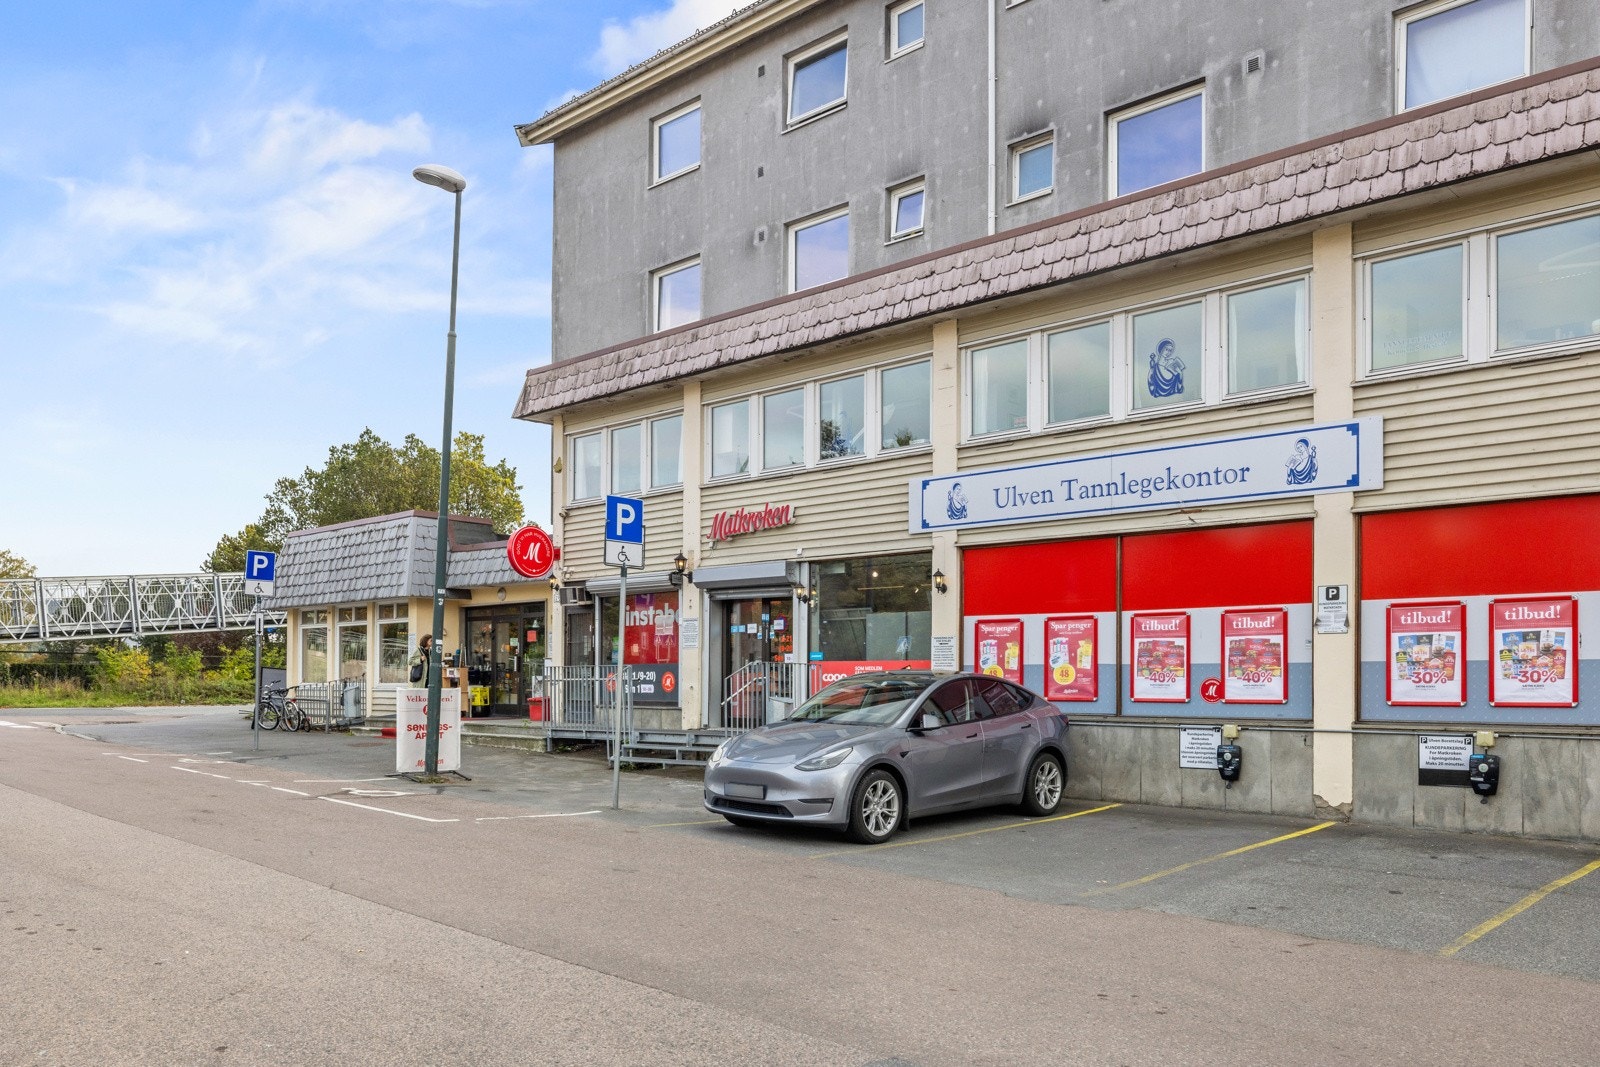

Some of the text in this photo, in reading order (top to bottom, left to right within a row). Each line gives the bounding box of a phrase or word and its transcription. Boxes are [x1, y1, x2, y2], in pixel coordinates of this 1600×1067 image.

[992, 466, 1251, 509] Ulven Tannlegekontor
[616, 502, 636, 536] P
[706, 502, 792, 541] Matkroken
[522, 542, 543, 564] M
[252, 554, 269, 577] P
[1329, 588, 1338, 599] P
[1400, 610, 1452, 624] tilbud!
[1504, 604, 1561, 621] tilbud!
[1050, 621, 1092, 631] Spar penger
[1141, 619, 1180, 631] tilbud!
[1232, 615, 1275, 629] tilbud!
[981, 624, 1019, 634] Spar penger
[1059, 669, 1070, 679] 48
[1144, 671, 1177, 684] -40%
[1237, 671, 1273, 684] -40%
[406, 694, 453, 703] Velkoen!
[415, 731, 444, 740] ÅPT
